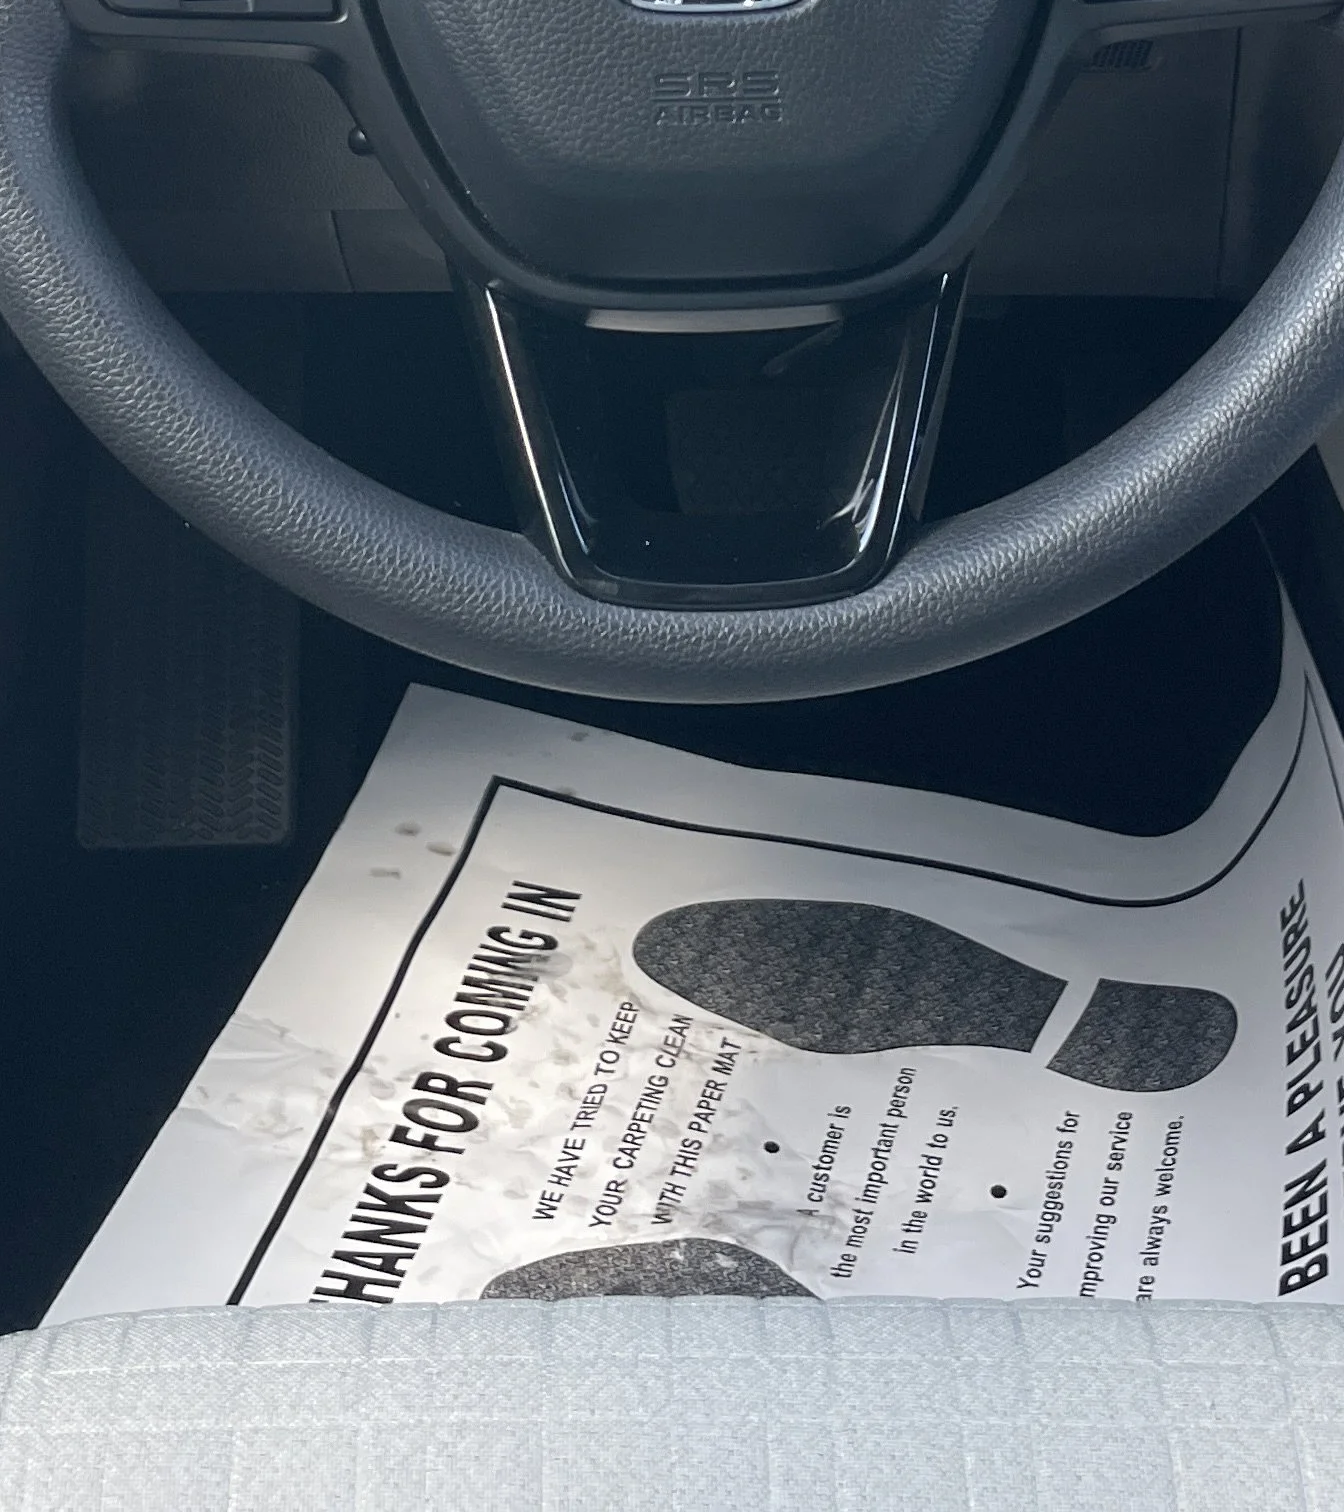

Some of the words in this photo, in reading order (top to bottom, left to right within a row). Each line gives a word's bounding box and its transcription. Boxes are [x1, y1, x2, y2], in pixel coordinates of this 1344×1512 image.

[656, 72, 781, 98] SRS
[656, 104, 784, 127] AIRBAG
[501, 880, 582, 922] IN
[433, 925, 559, 1063] COMING
[1280, 878, 1324, 1118] PLEASURE
[608, 1001, 641, 1045] KEEP
[594, 1050, 620, 1076] TO
[388, 1071, 494, 1155] FOR
[570, 1083, 608, 1131] TRIED
[886, 1067, 917, 1119] person
[588, 1179, 628, 1228] YOUR
[613, 1074, 669, 1169] CARPETING
[656, 1014, 694, 1068] CLEAN
[651, 1182, 687, 1225] WITH
[670, 1137, 702, 1177] THIS
[688, 1079, 727, 1134] PAPER
[712, 1036, 742, 1076] MAT
[926, 1133, 949, 1149] to
[1107, 1111, 1133, 1171] service
[1284, 1108, 1327, 1156] A
[547, 1138, 586, 1187] HAVE
[808, 1122, 845, 1203] customer
[827, 1104, 852, 1119] is
[855, 1122, 899, 1204] important
[1154, 1115, 1185, 1197] welcome.
[915, 1154, 943, 1204] world
[1016, 1249, 1048, 1289] Your
[1035, 1140, 1073, 1244] suggestions
[1056, 1110, 1080, 1134] for
[1100, 1177, 1120, 1207] our
[532, 1190, 565, 1220] WE
[846, 1208, 874, 1248] most
[902, 1210, 928, 1233] the
[1277, 1158, 1329, 1297] BEEN
[308, 1163, 450, 1304] HANKS
[892, 1239, 919, 1254] in
[1079, 1213, 1117, 1298] mproving
[1138, 1205, 1171, 1267] always
[829, 1253, 858, 1279] the
[1136, 1275, 1156, 1305] are
